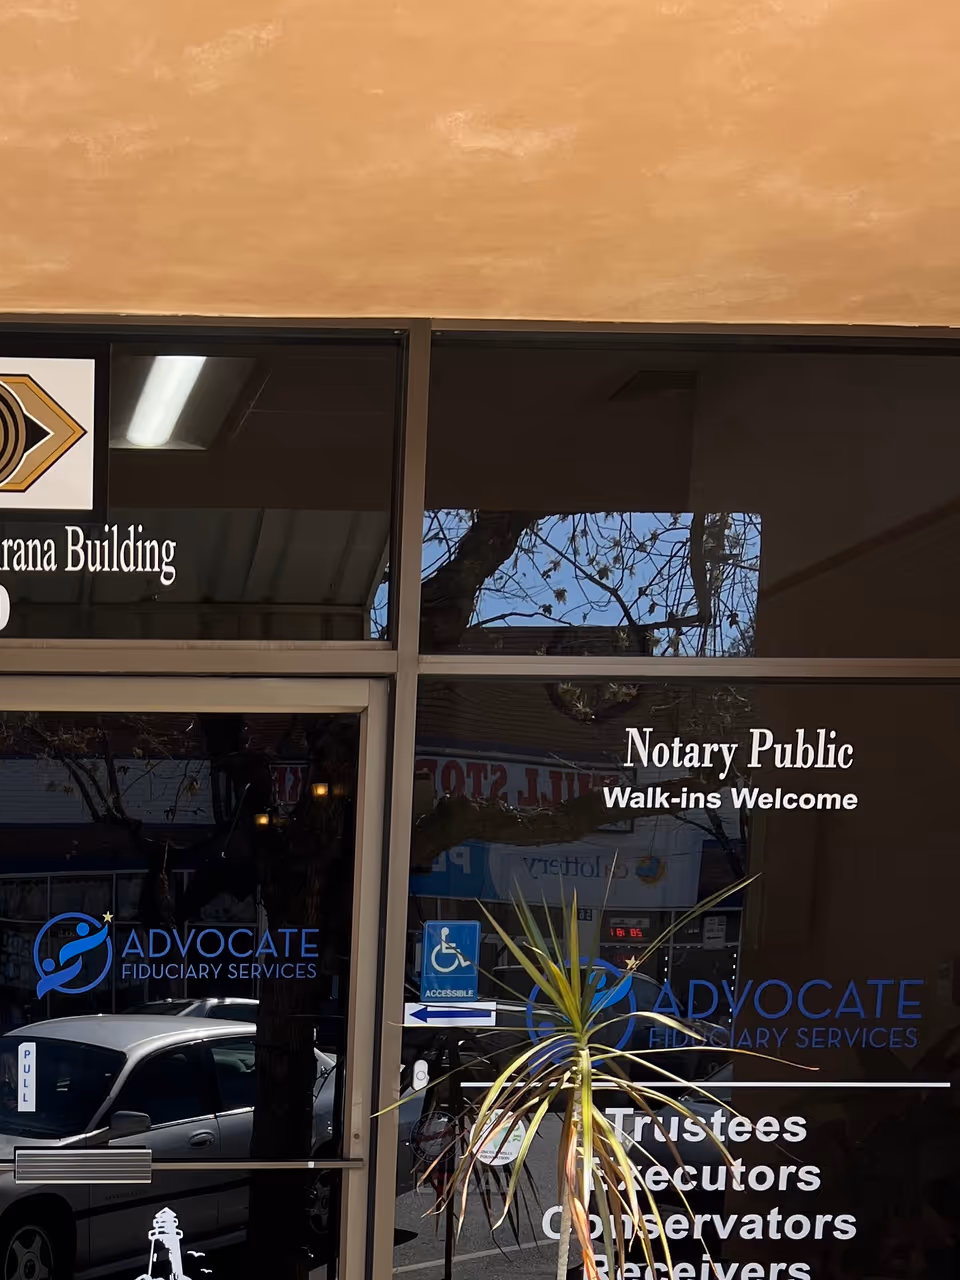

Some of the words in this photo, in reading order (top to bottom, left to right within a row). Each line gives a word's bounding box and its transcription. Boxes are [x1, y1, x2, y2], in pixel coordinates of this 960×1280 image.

[65, 523, 177, 585] Building
[623, 727, 738, 780] Notary
[747, 728, 854, 769] Public
[603, 786, 722, 809] Walk-ins
[731, 787, 858, 810] Welcome
[121, 928, 320, 958] ADVOCATE
[121, 962, 221, 980] FIDUCIARY
[227, 962, 317, 980] SERVICES
[424, 989, 474, 998] ACCESSIBLE
[651, 978, 925, 1020] ADVOCATE
[648, 1027, 789, 1048] FIDUCIARY
[795, 1027, 919, 1049] SERVICES
[23, 1050, 31, 1103] PULL
[605, 1107, 808, 1143] Trustees
[541, 1206, 857, 1240] Conservators
